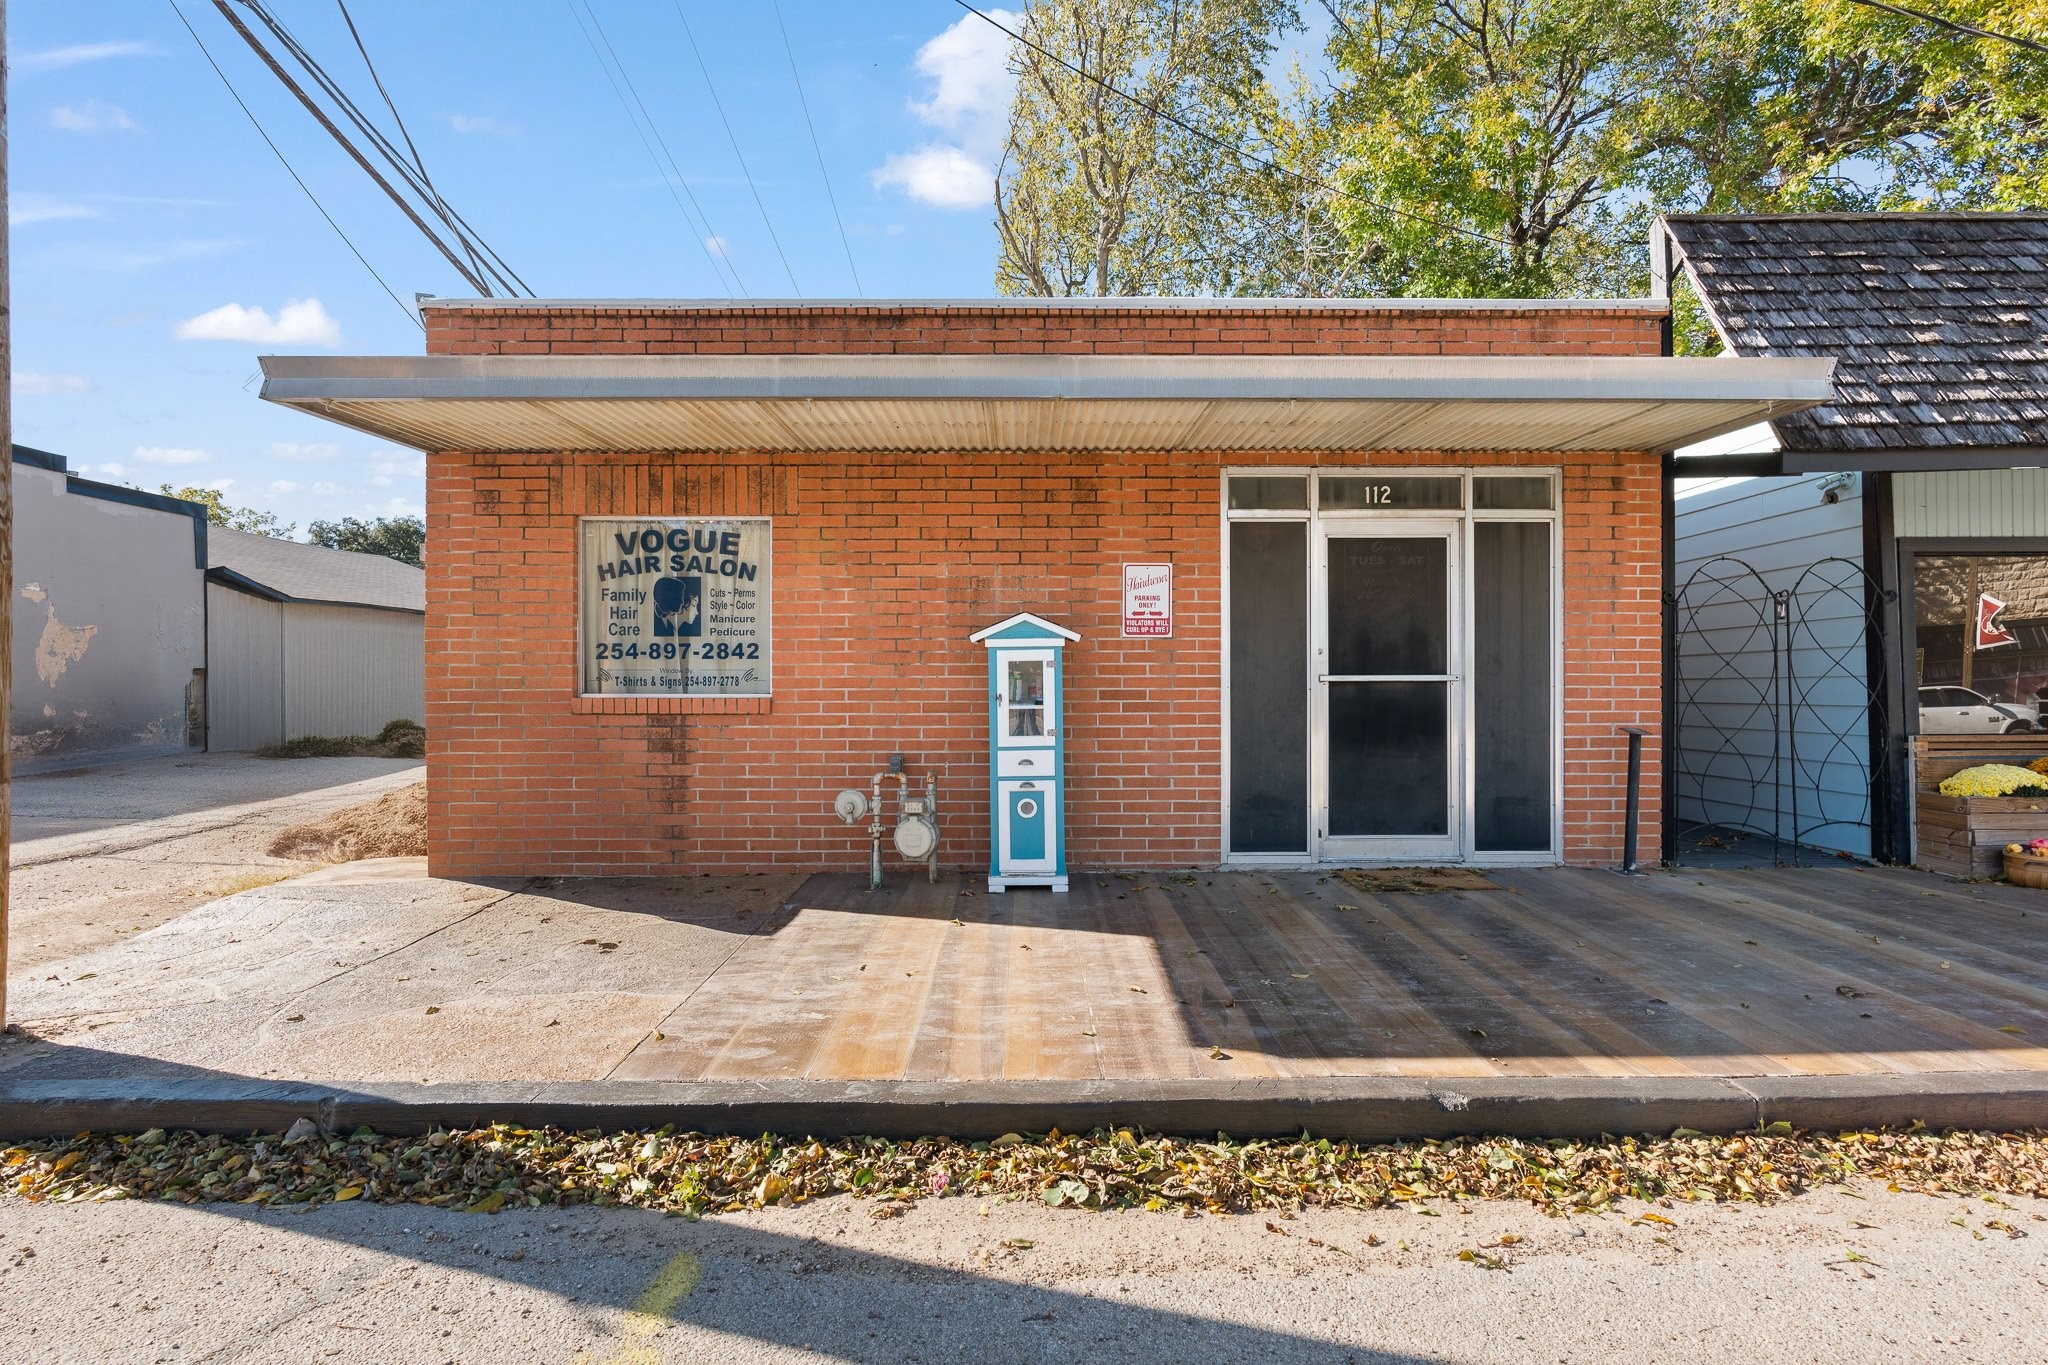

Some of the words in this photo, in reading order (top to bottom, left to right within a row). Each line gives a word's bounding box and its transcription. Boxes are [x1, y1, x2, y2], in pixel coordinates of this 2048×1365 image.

[1365, 486, 1391, 503] 112
[614, 529, 741, 556] VOGUE
[1350, 556, 1386, 566] TUES
[1398, 556, 1424, 565] SAT
[597, 556, 661, 582] HAIR
[670, 555, 757, 582] SALON
[601, 588, 647, 604] Family
[710, 588, 726, 598] Cuts
[733, 588, 756, 598] Perms
[710, 600, 728, 610] Style
[735, 600, 756, 610] Color
[610, 606, 639, 620] Hair
[710, 614, 756, 623] Manicure
[608, 623, 640, 636] Care
[710, 627, 756, 636] Pedicure
[595, 642, 760, 660] 254-897-2842
[615, 676, 648, 687] T-Shirts
[650, 676, 656, 686] &
[659, 676, 682, 689] Signs
[685, 676, 740, 687] 254-897-2778
